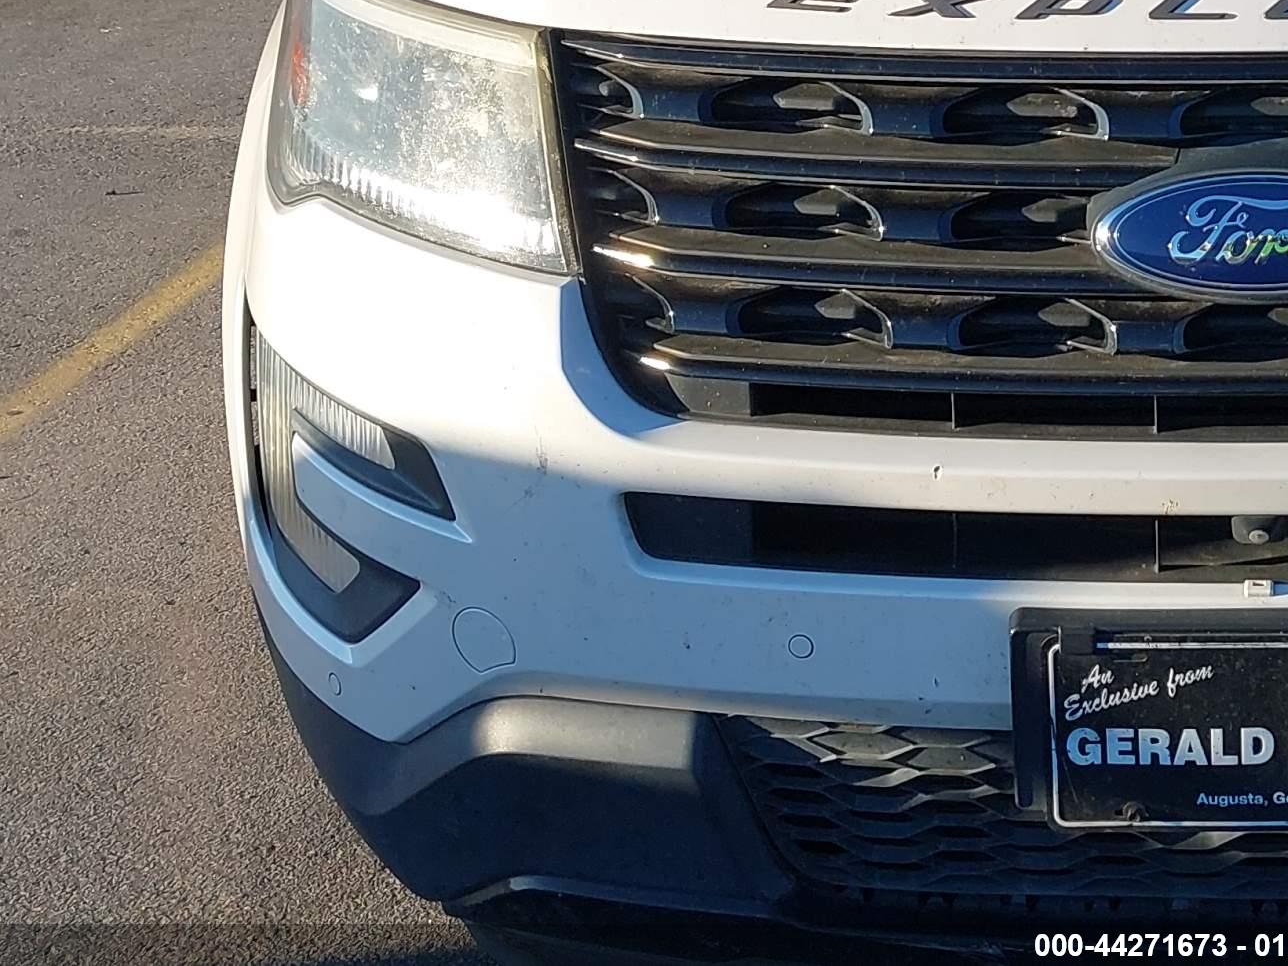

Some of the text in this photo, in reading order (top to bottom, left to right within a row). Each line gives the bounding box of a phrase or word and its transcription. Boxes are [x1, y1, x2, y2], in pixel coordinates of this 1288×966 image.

[1063, 665, 1214, 721] Exclusive from
[1081, 664, 1115, 693] An
[1066, 726, 1275, 766] GERALD
[1196, 792, 1268, 808] Augusta,
